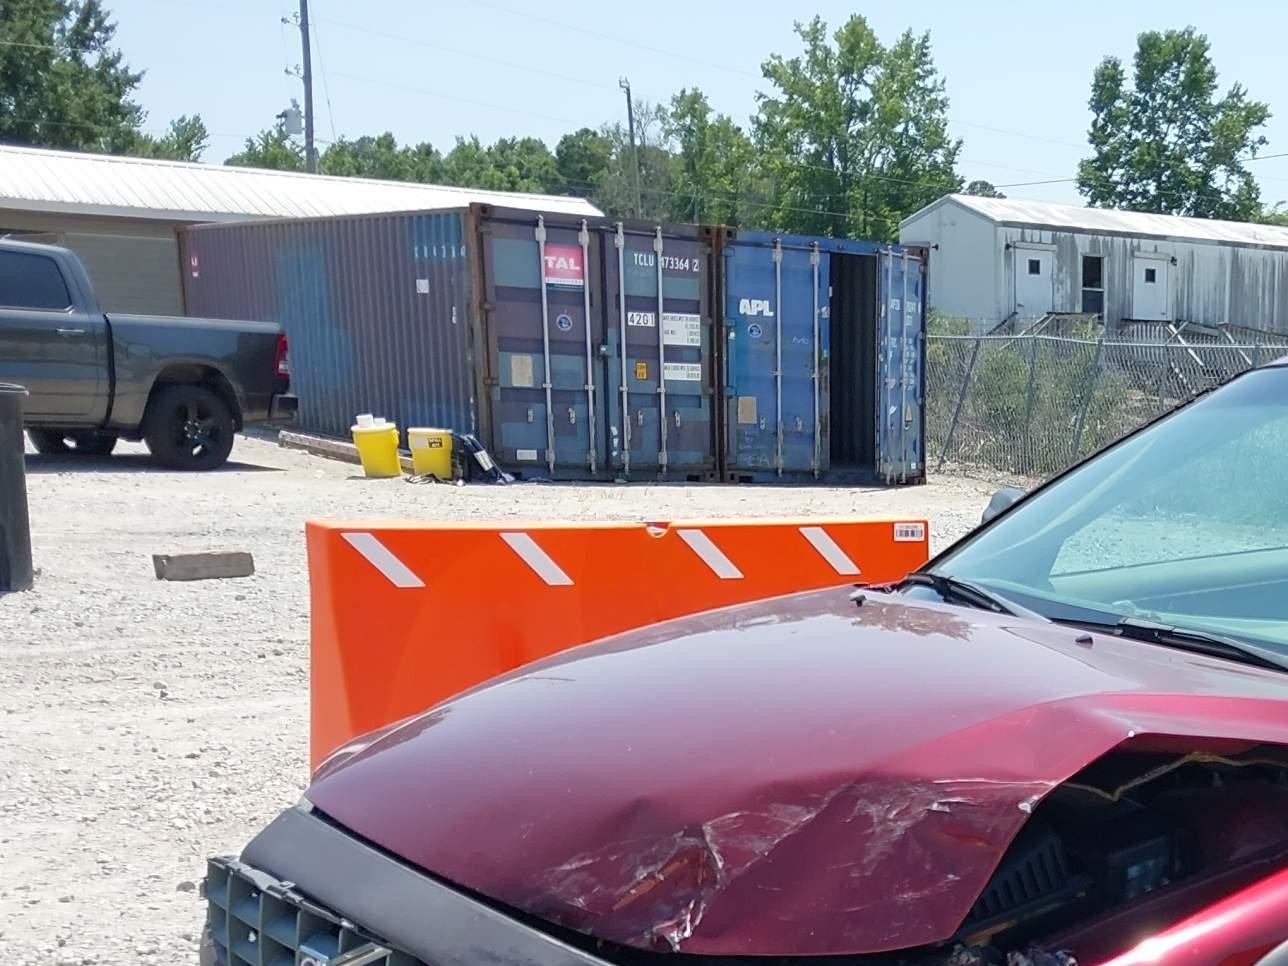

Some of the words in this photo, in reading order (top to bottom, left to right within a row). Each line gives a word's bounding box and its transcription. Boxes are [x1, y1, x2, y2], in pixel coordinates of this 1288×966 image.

[544, 255, 580, 271] TAL
[633, 253, 655, 267] TCLU
[692, 259, 699, 272] 2
[739, 298, 774, 317] APL
[629, 312, 655, 326] 42G1
